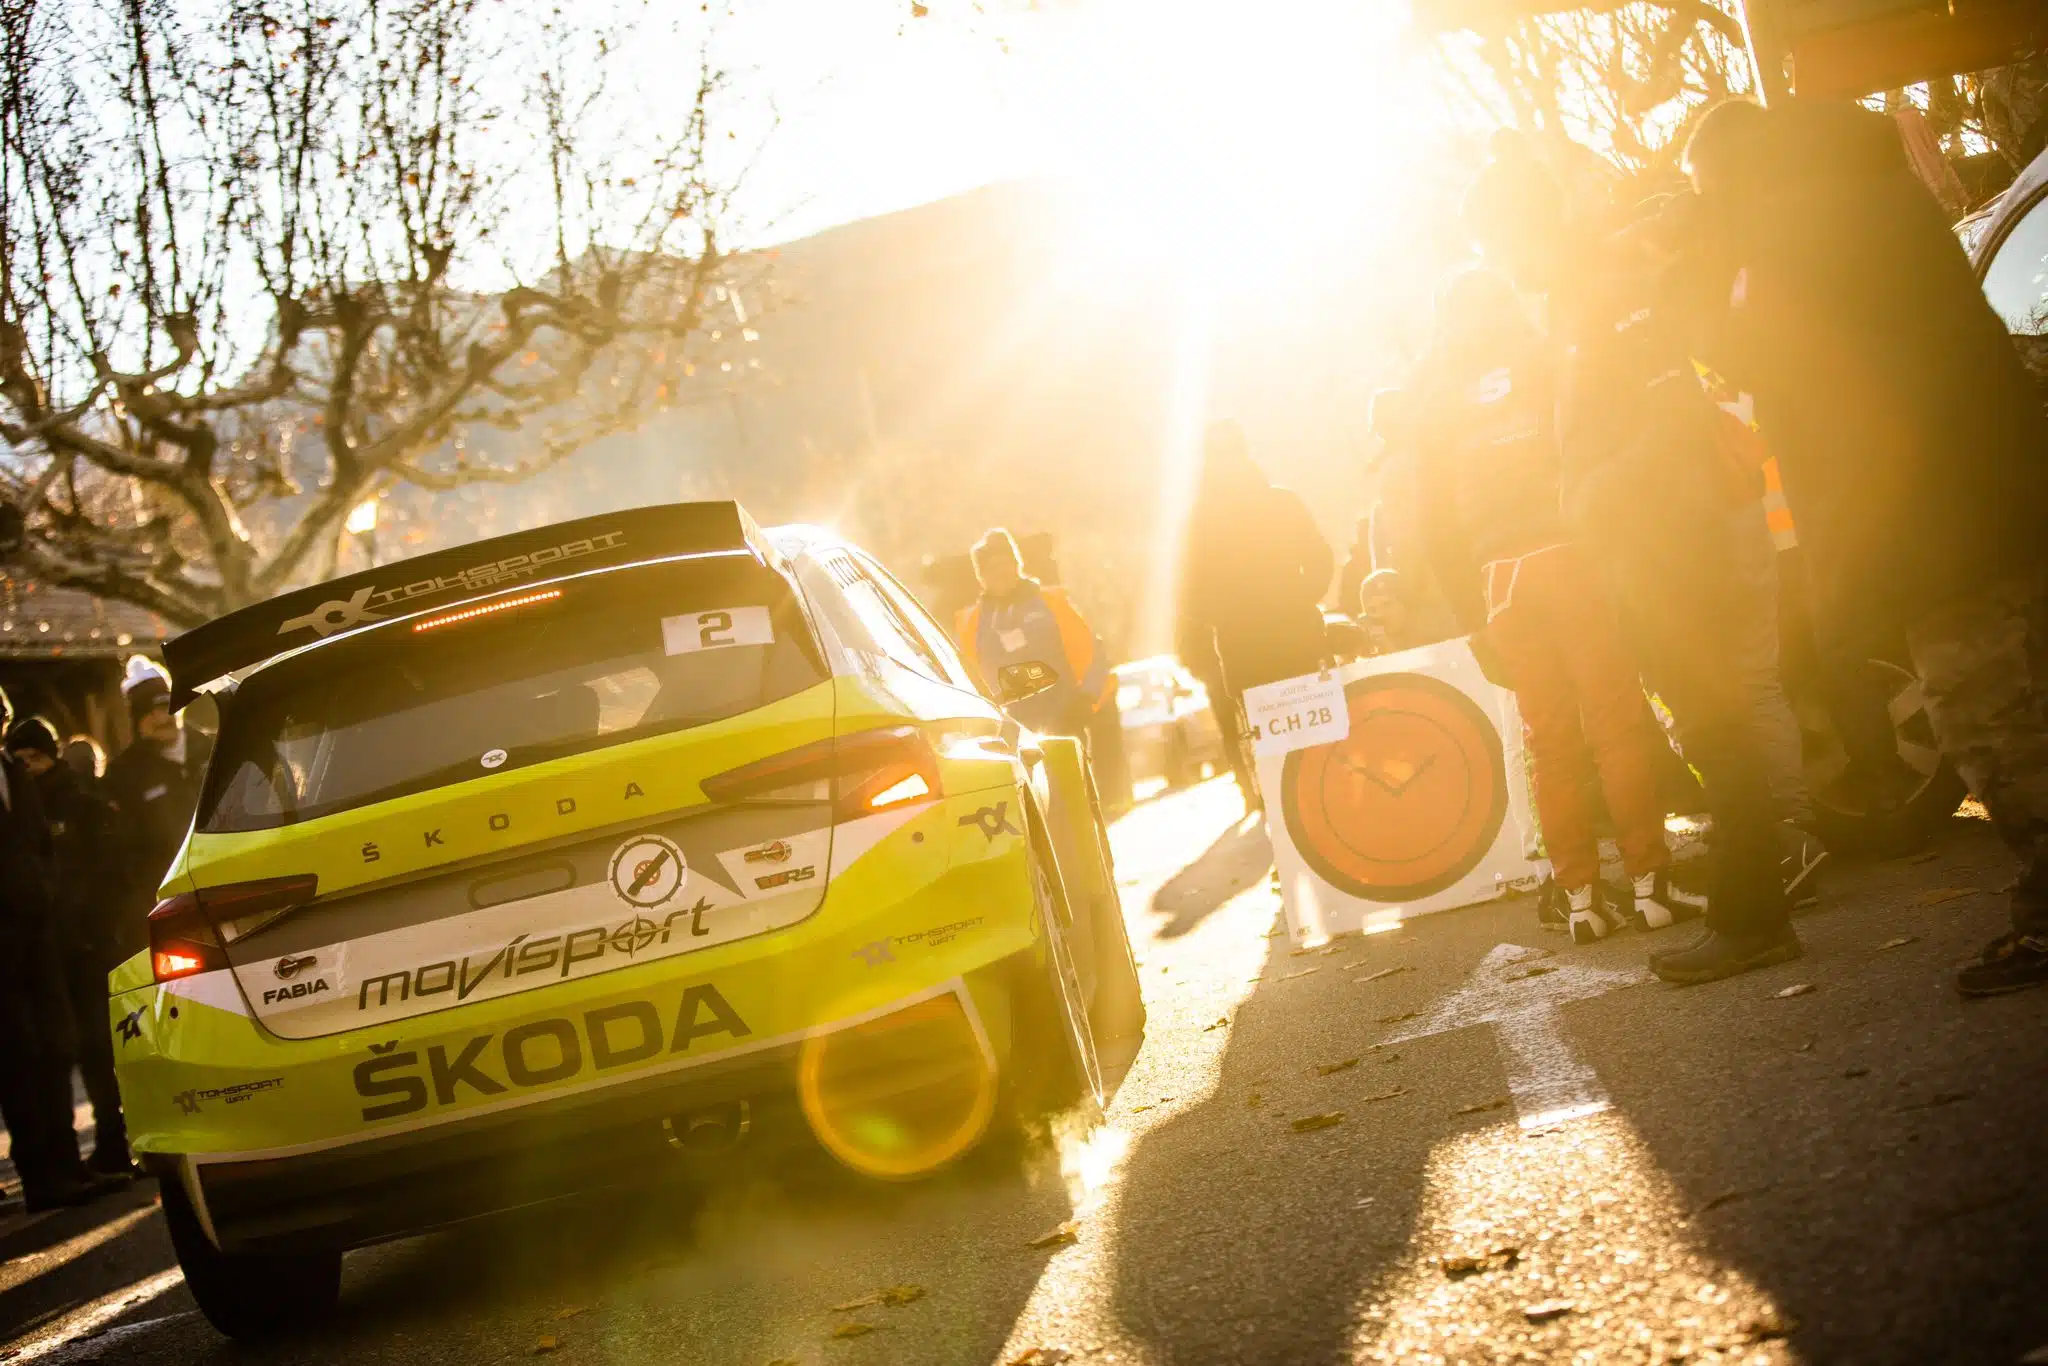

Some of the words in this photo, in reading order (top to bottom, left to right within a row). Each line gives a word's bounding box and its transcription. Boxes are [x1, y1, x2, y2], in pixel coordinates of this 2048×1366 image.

[698, 611, 735, 648] 2
[1268, 712, 1302, 736] C.H
[1306, 707, 1333, 728] 2B
[361, 782, 644, 863] ŠKODA
[263, 978, 329, 1006] FABIA
[353, 983, 752, 1122] ŠKODA
